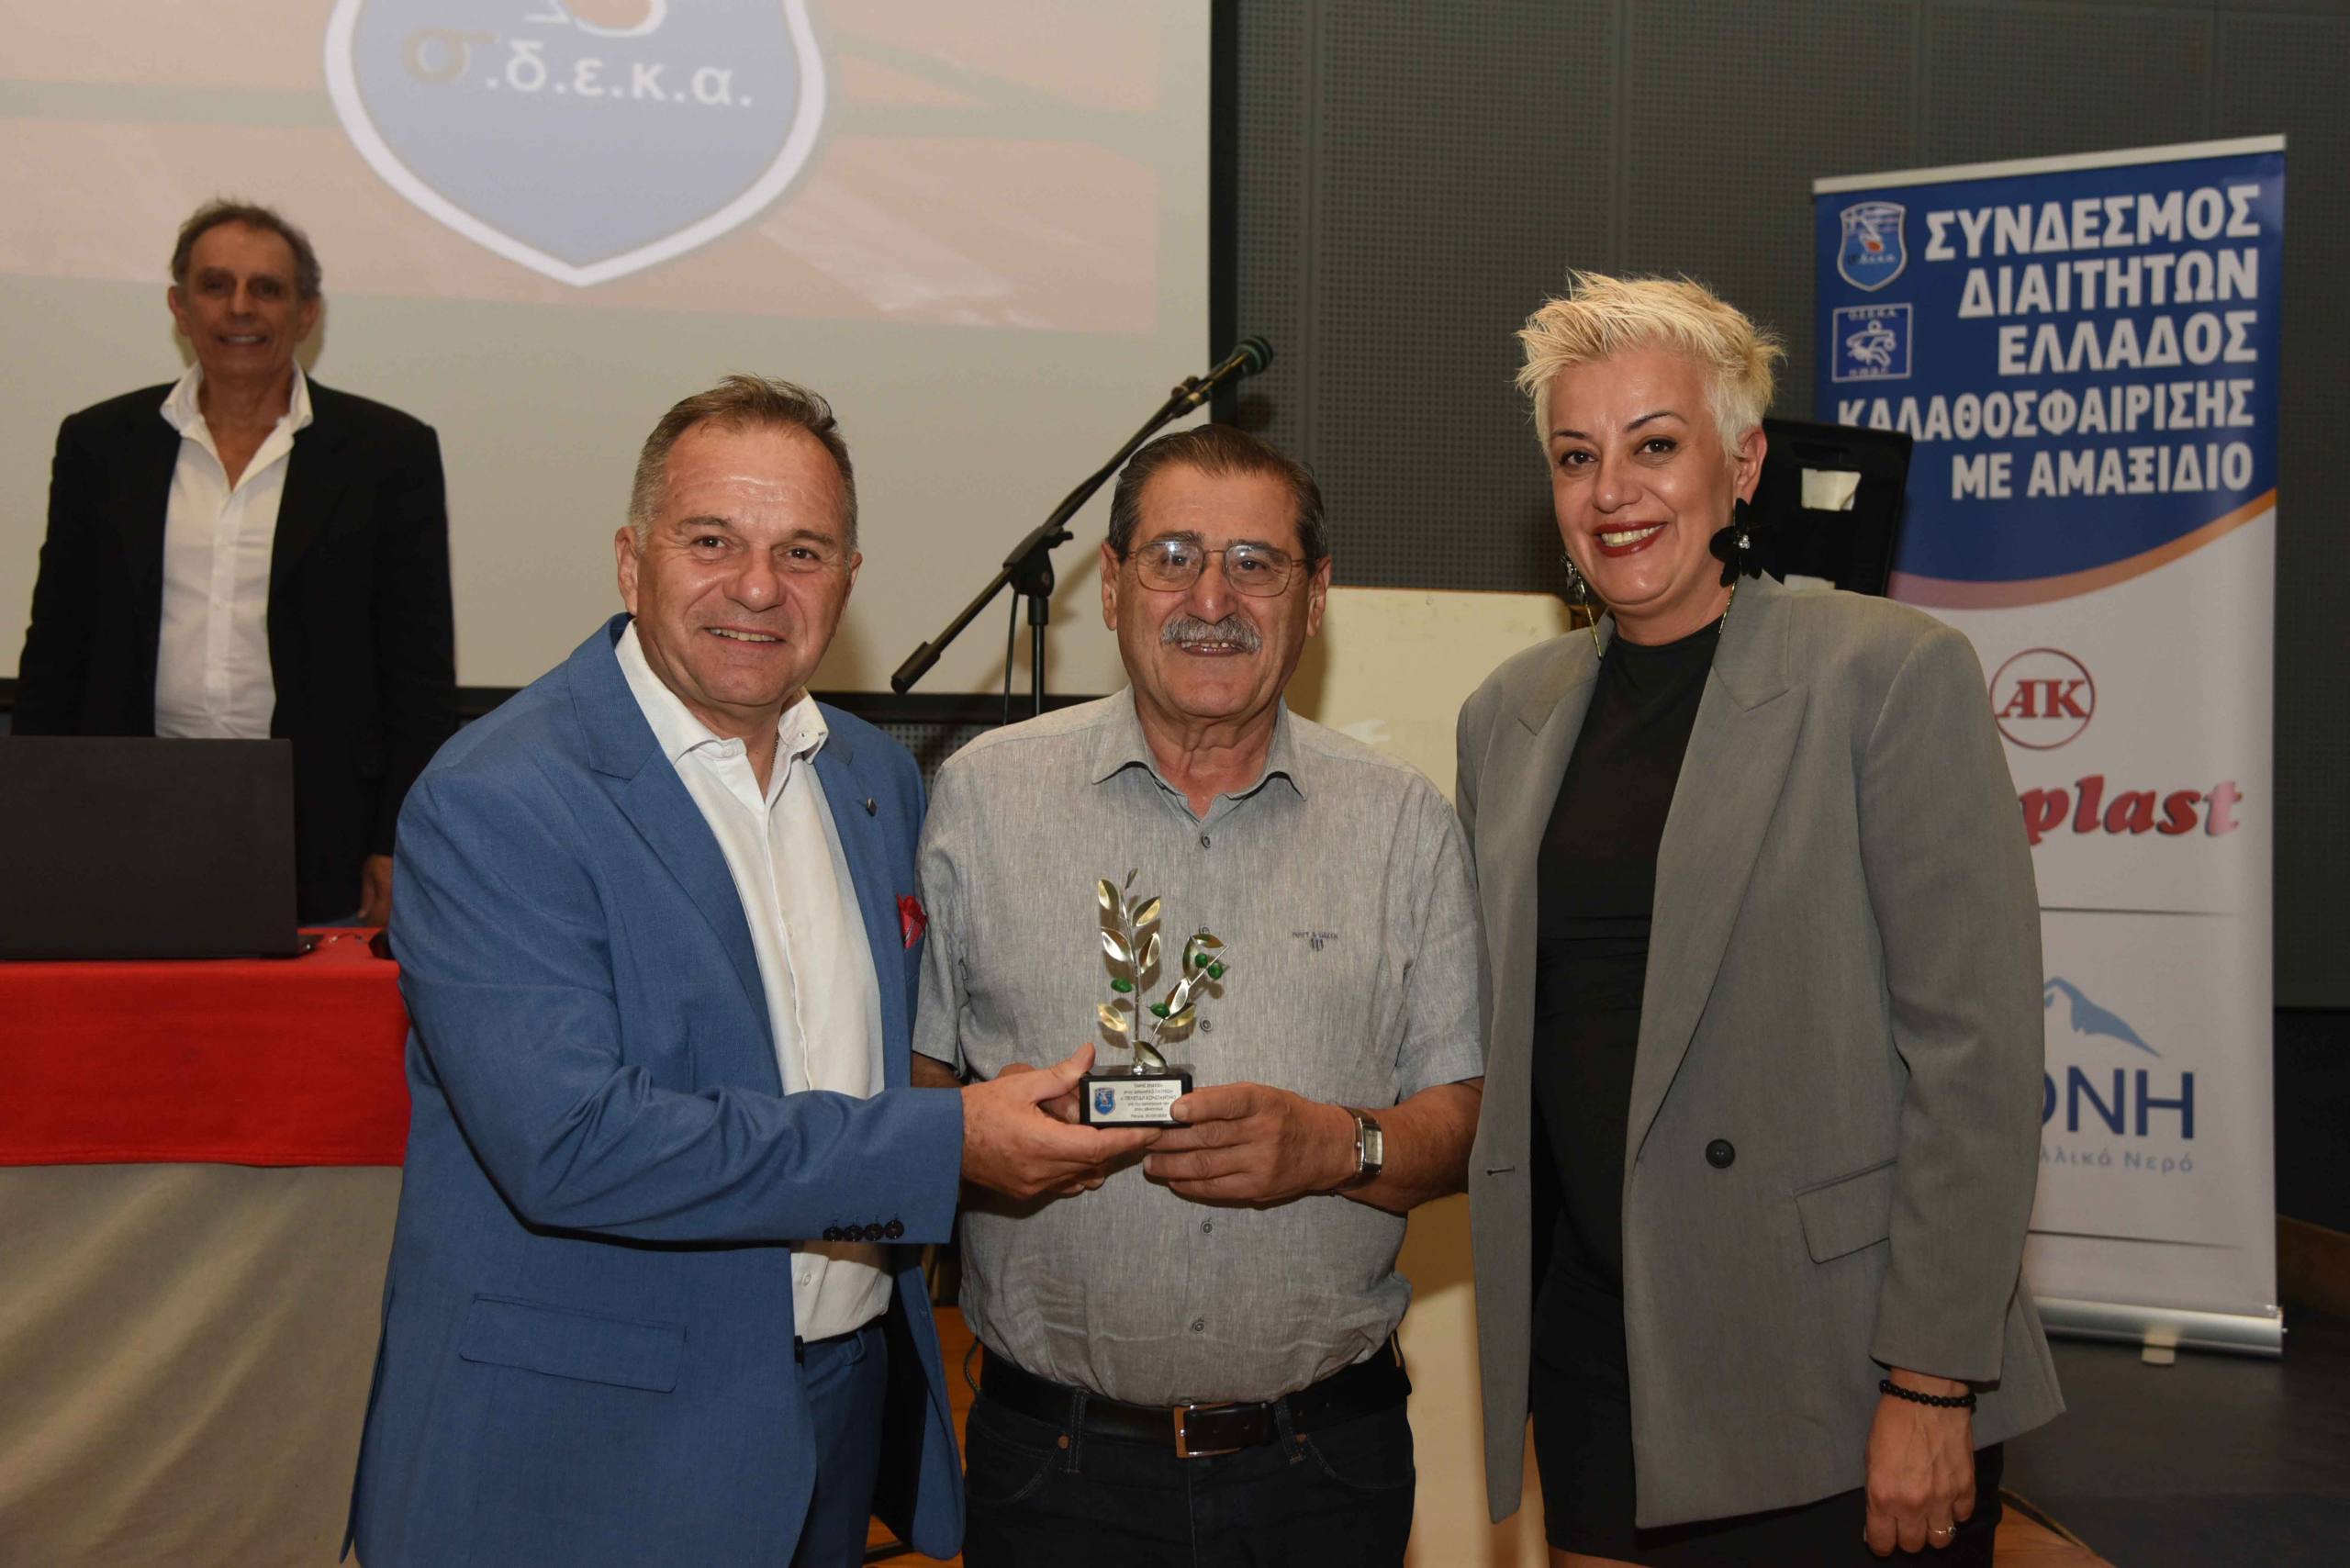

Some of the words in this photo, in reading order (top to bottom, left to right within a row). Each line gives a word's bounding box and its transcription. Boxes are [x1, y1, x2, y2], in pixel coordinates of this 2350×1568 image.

[1925, 185, 2261, 262] ΣΥΝΔΕΣΜΟΣ
[1958, 249, 2259, 319] ΔΙΑΙΤΗΤΩΝ
[1998, 311, 2258, 375] ΕΛΛΑΔΟΣ
[1952, 453, 2013, 500] ΜΕ
[2027, 442, 2254, 498] ΑΜΑΞΙΔΙΟ
[1996, 679, 2088, 719] AK
[2042, 1065, 2195, 1140] ΝΗ
[2123, 1150, 2195, 1176] Νερό
